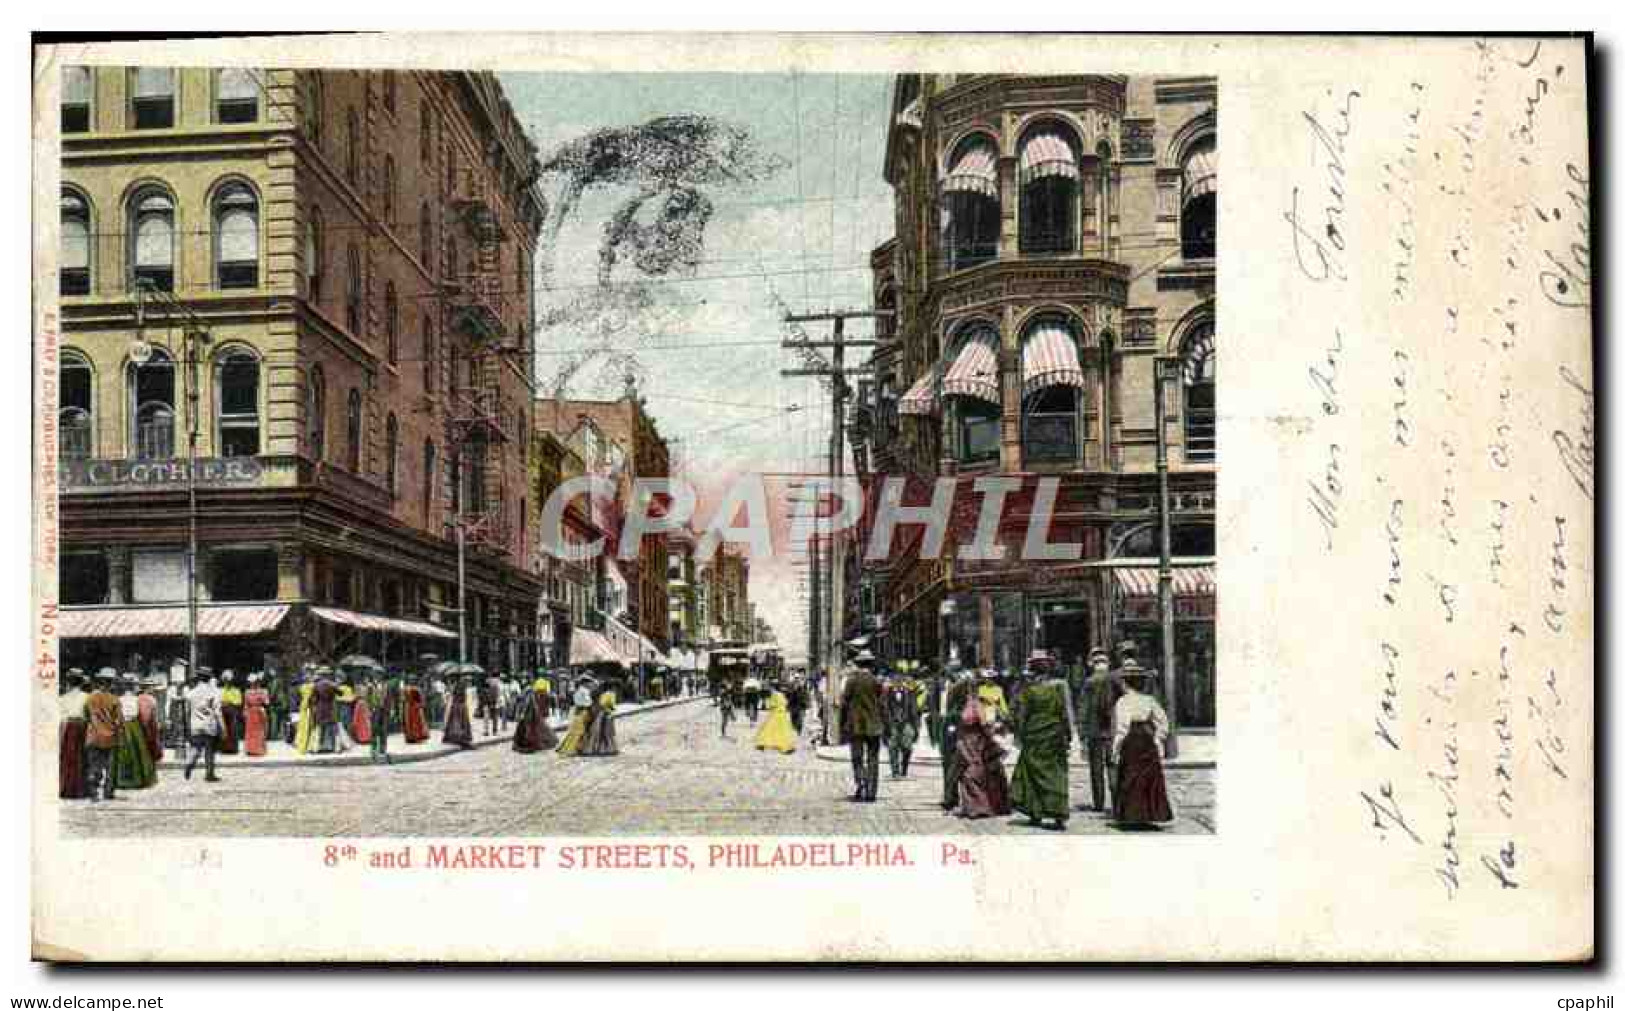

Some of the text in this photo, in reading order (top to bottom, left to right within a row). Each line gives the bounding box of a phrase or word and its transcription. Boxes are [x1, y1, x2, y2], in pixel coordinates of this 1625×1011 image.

[89, 460, 259, 485] CLOTHER
[369, 847, 411, 869] and
[427, 844, 546, 869] MARKET
[557, 844, 695, 871] STREETS,
[708, 843, 915, 868] PHILADELPHIA.
[941, 843, 977, 866] Pa.
